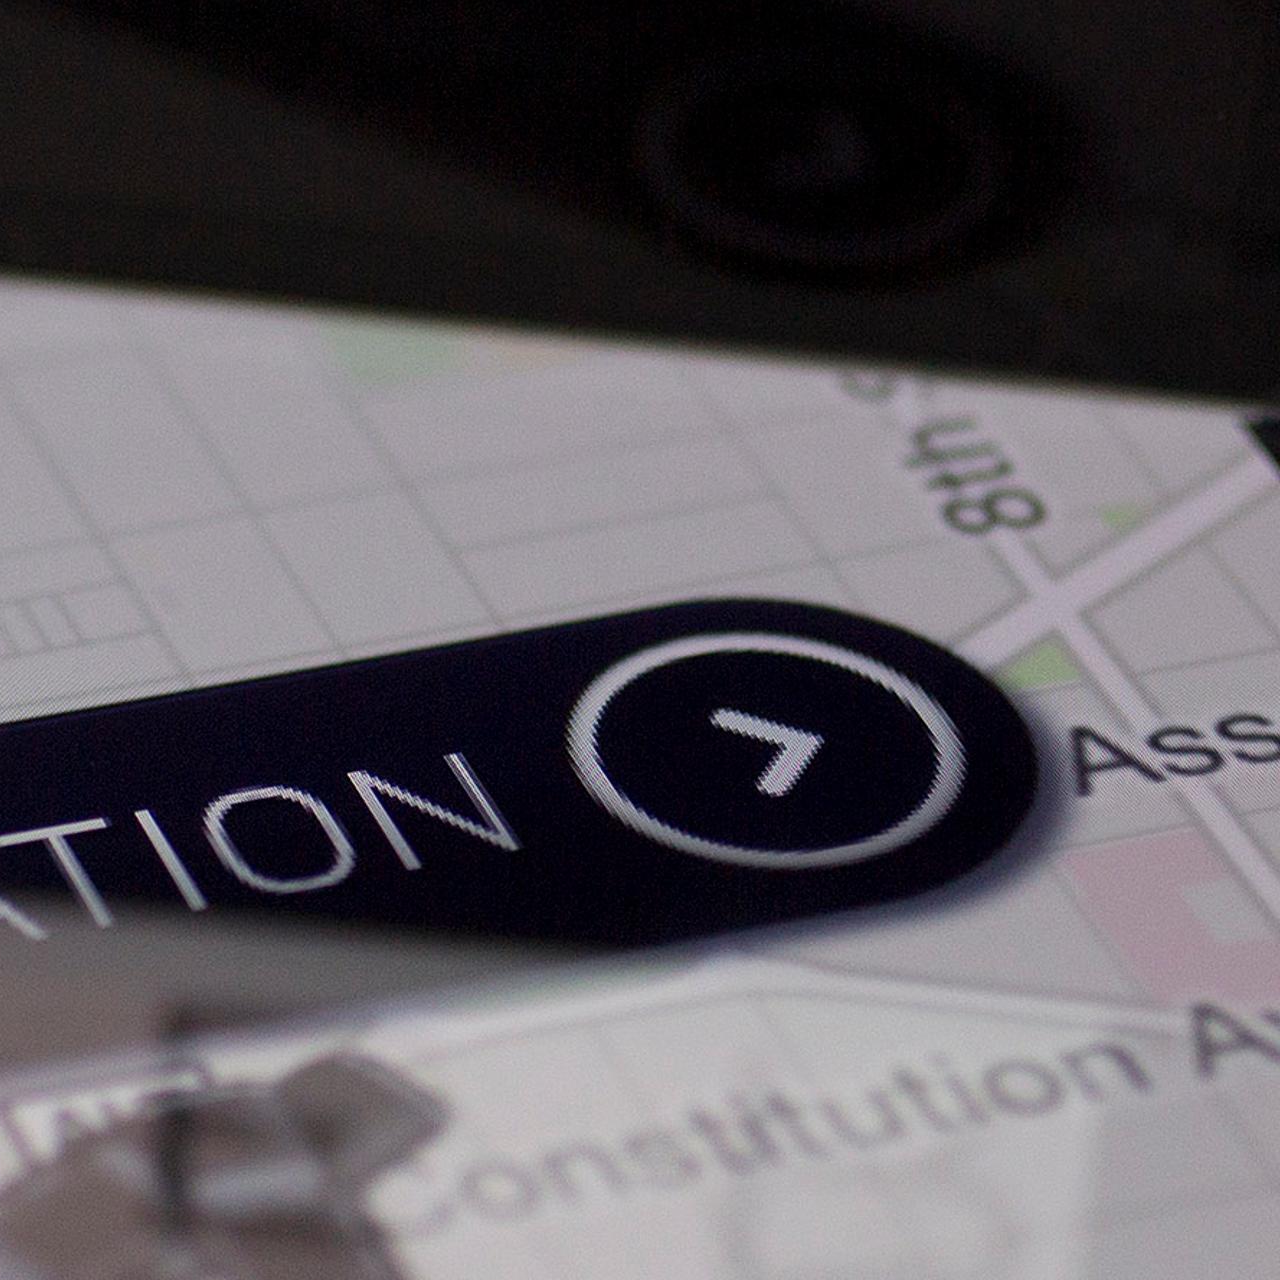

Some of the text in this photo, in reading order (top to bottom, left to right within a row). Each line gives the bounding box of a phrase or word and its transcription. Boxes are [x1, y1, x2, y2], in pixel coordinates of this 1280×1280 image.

[905, 414, 1046, 535] 8th
[1068, 712, 1280, 798] Ass
[1188, 1000, 1280, 1082] A
